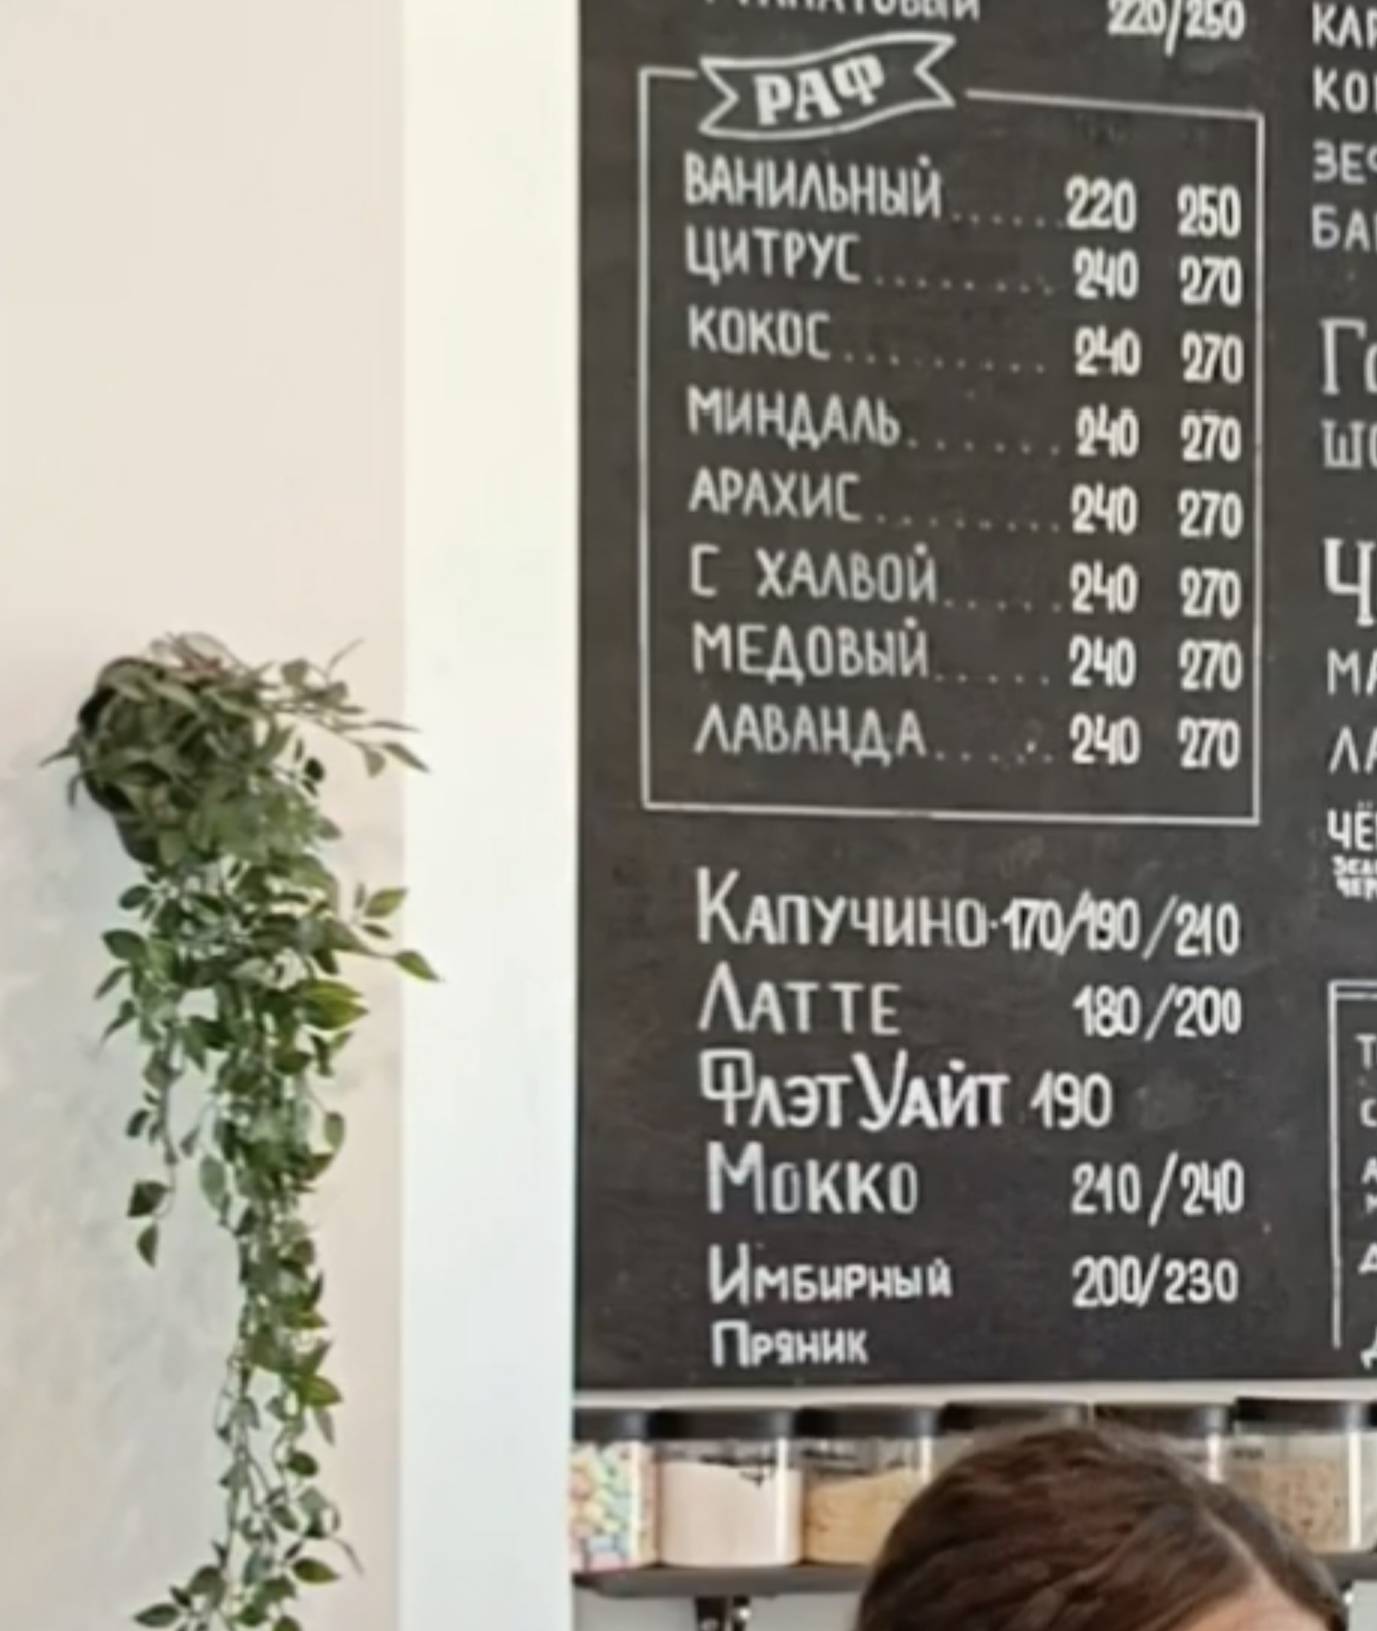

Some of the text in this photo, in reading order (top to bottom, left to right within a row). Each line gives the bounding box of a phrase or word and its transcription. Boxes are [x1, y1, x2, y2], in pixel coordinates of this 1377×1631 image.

[754, 54, 885, 125] РАФ
[684, 152, 1241, 238] ВАНИЛЬНЫЙ 220 250
[686, 225, 1242, 305] ЦИТРУС 240 270
[689, 305, 1244, 383] КОКОС 240 270
[688, 386, 1241, 462] МИНДАЛЬ 240 270
[690, 469, 1243, 538] АРАХИС 240 270
[691, 544, 1241, 618] С ХАЛВОЙ 240 270
[694, 617, 1243, 691] МЕДОВЫЙ 240 270
[694, 704, 1239, 769] ЛАВАНДА 240 270
[697, 867, 988, 948] КАПУЧИНО
[699, 962, 1241, 1042] ЛАТТЕ 180/200
[1031, 1073, 1111, 1129] 190
[707, 1142, 1244, 1227] МОККО 210/240
[709, 1243, 1237, 1308] ИМБИРНЫЙ 200/230
[711, 1320, 868, 1367] ПРЯНИК
